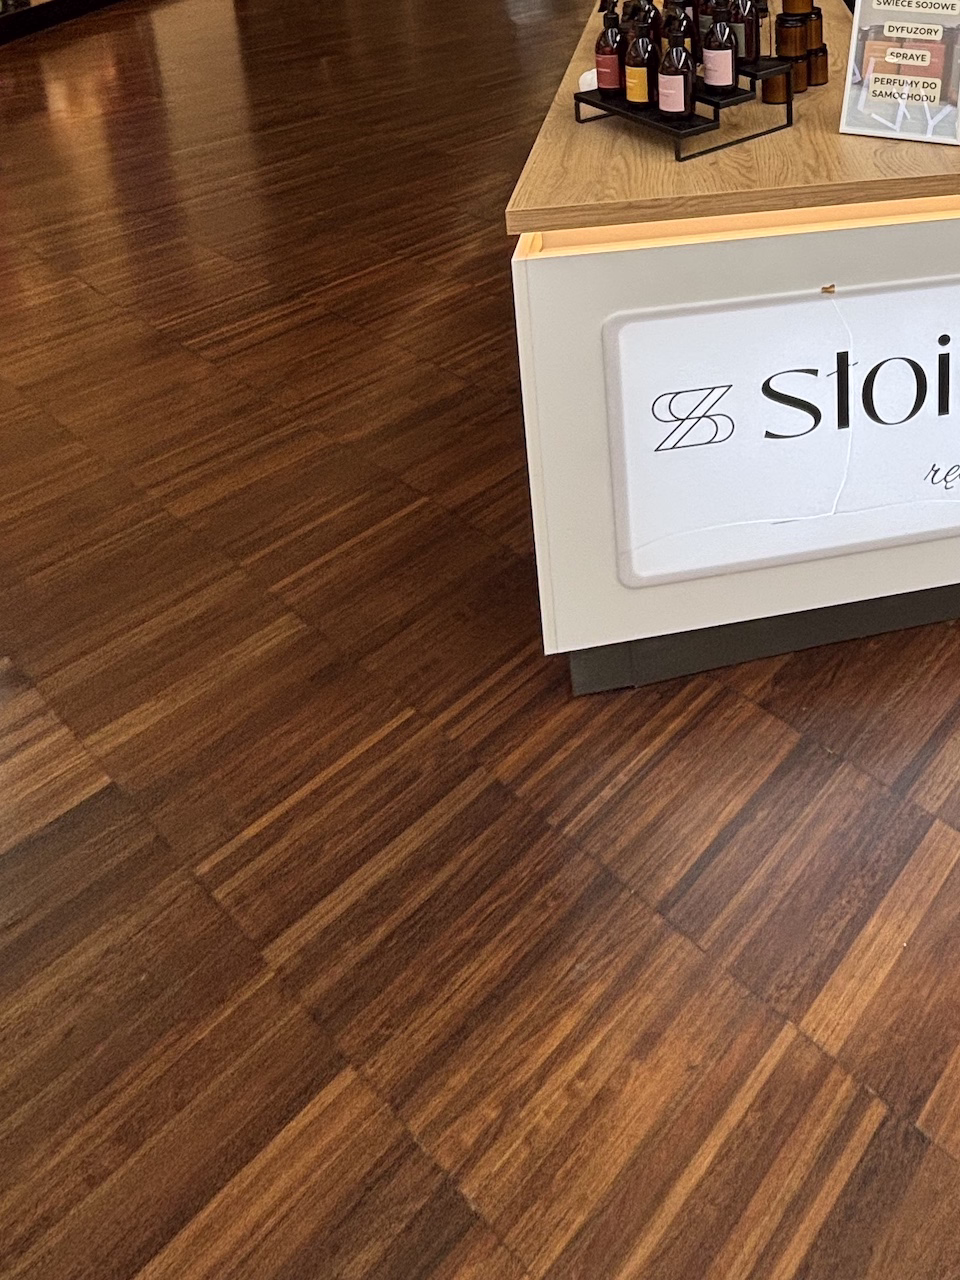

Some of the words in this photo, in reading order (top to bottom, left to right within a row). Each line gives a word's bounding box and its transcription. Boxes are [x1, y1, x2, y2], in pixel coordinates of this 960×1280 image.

[915, 0, 957, 11] SOJOWE
[887, 25, 940, 36] DYFUZORY
[889, 51, 927, 62] SPRAYE
[873, 77, 920, 88] PERFUMY
[922, 81, 937, 90] DO
[871, 90, 936, 103] SAMOCHODU
